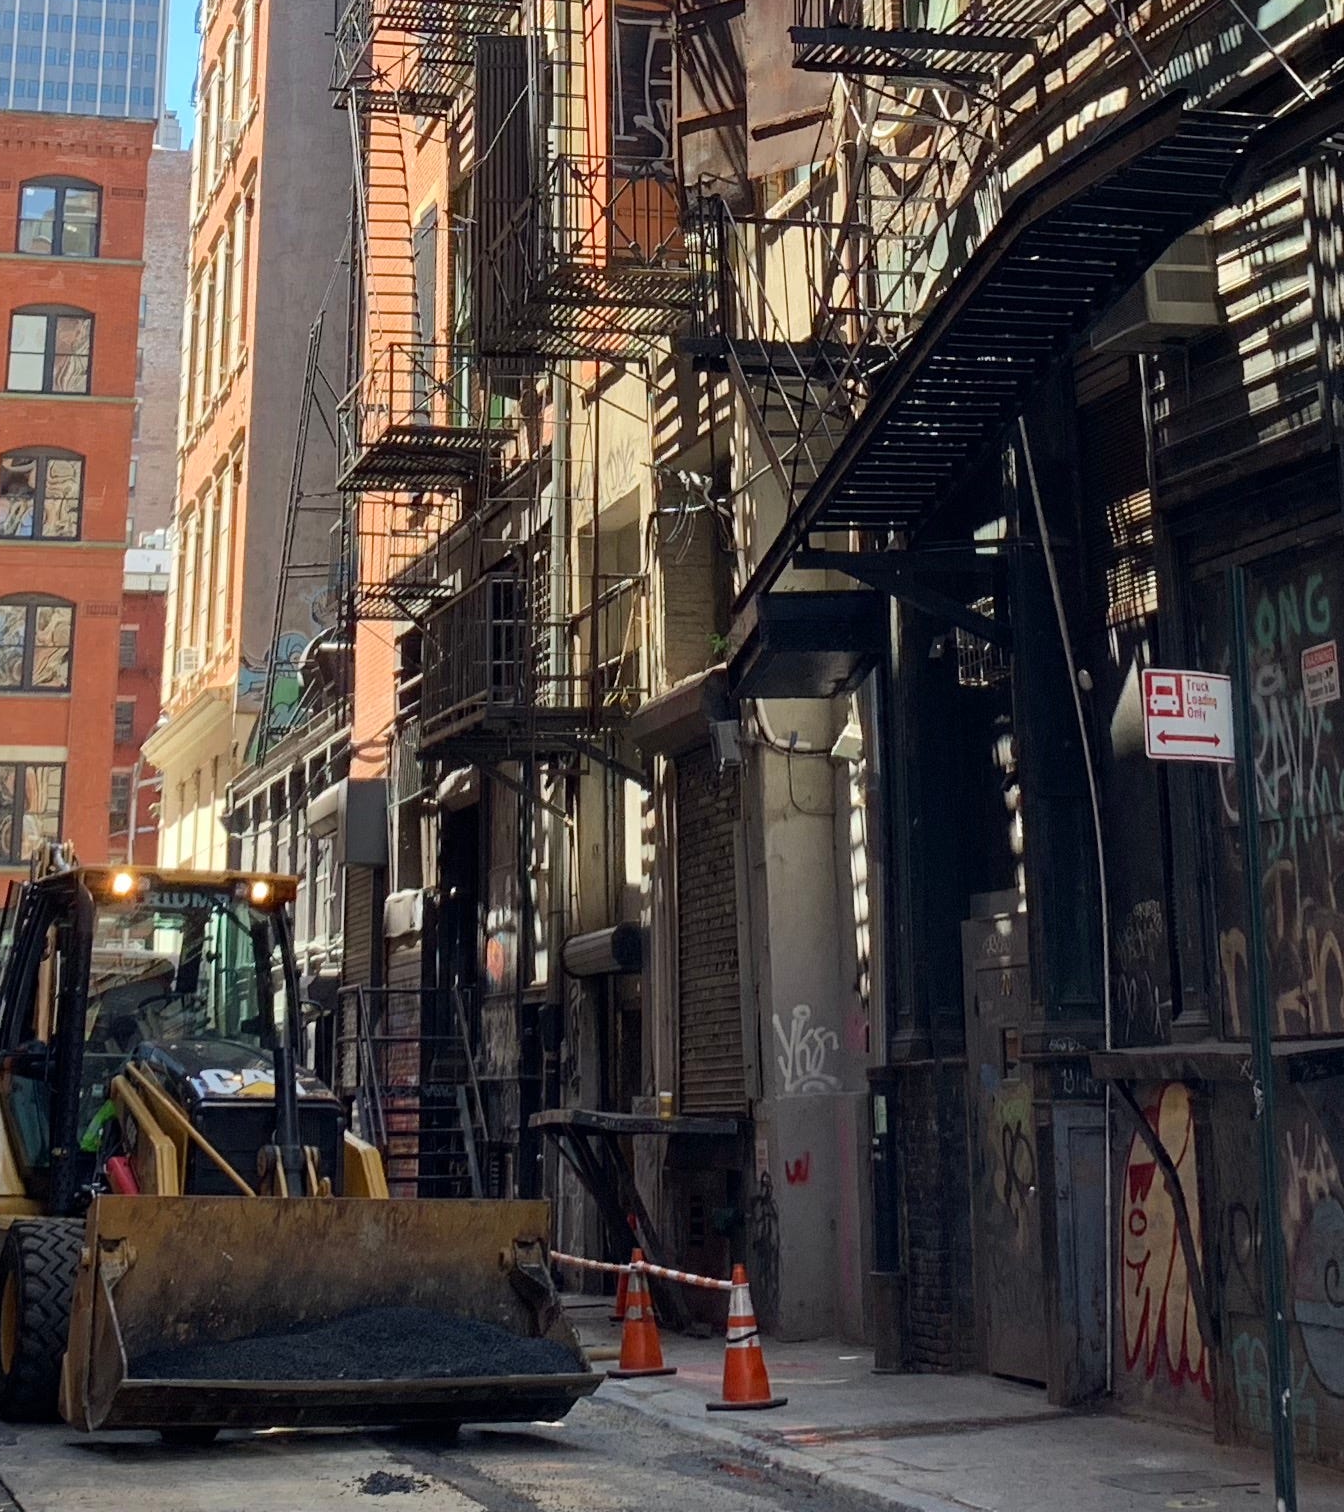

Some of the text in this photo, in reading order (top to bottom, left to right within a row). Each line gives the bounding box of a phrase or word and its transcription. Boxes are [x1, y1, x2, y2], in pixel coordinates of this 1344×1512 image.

[1186, 678, 1210, 692] Truck
[1186, 693, 1218, 710] Loading
[1187, 706, 1207, 723] Only
